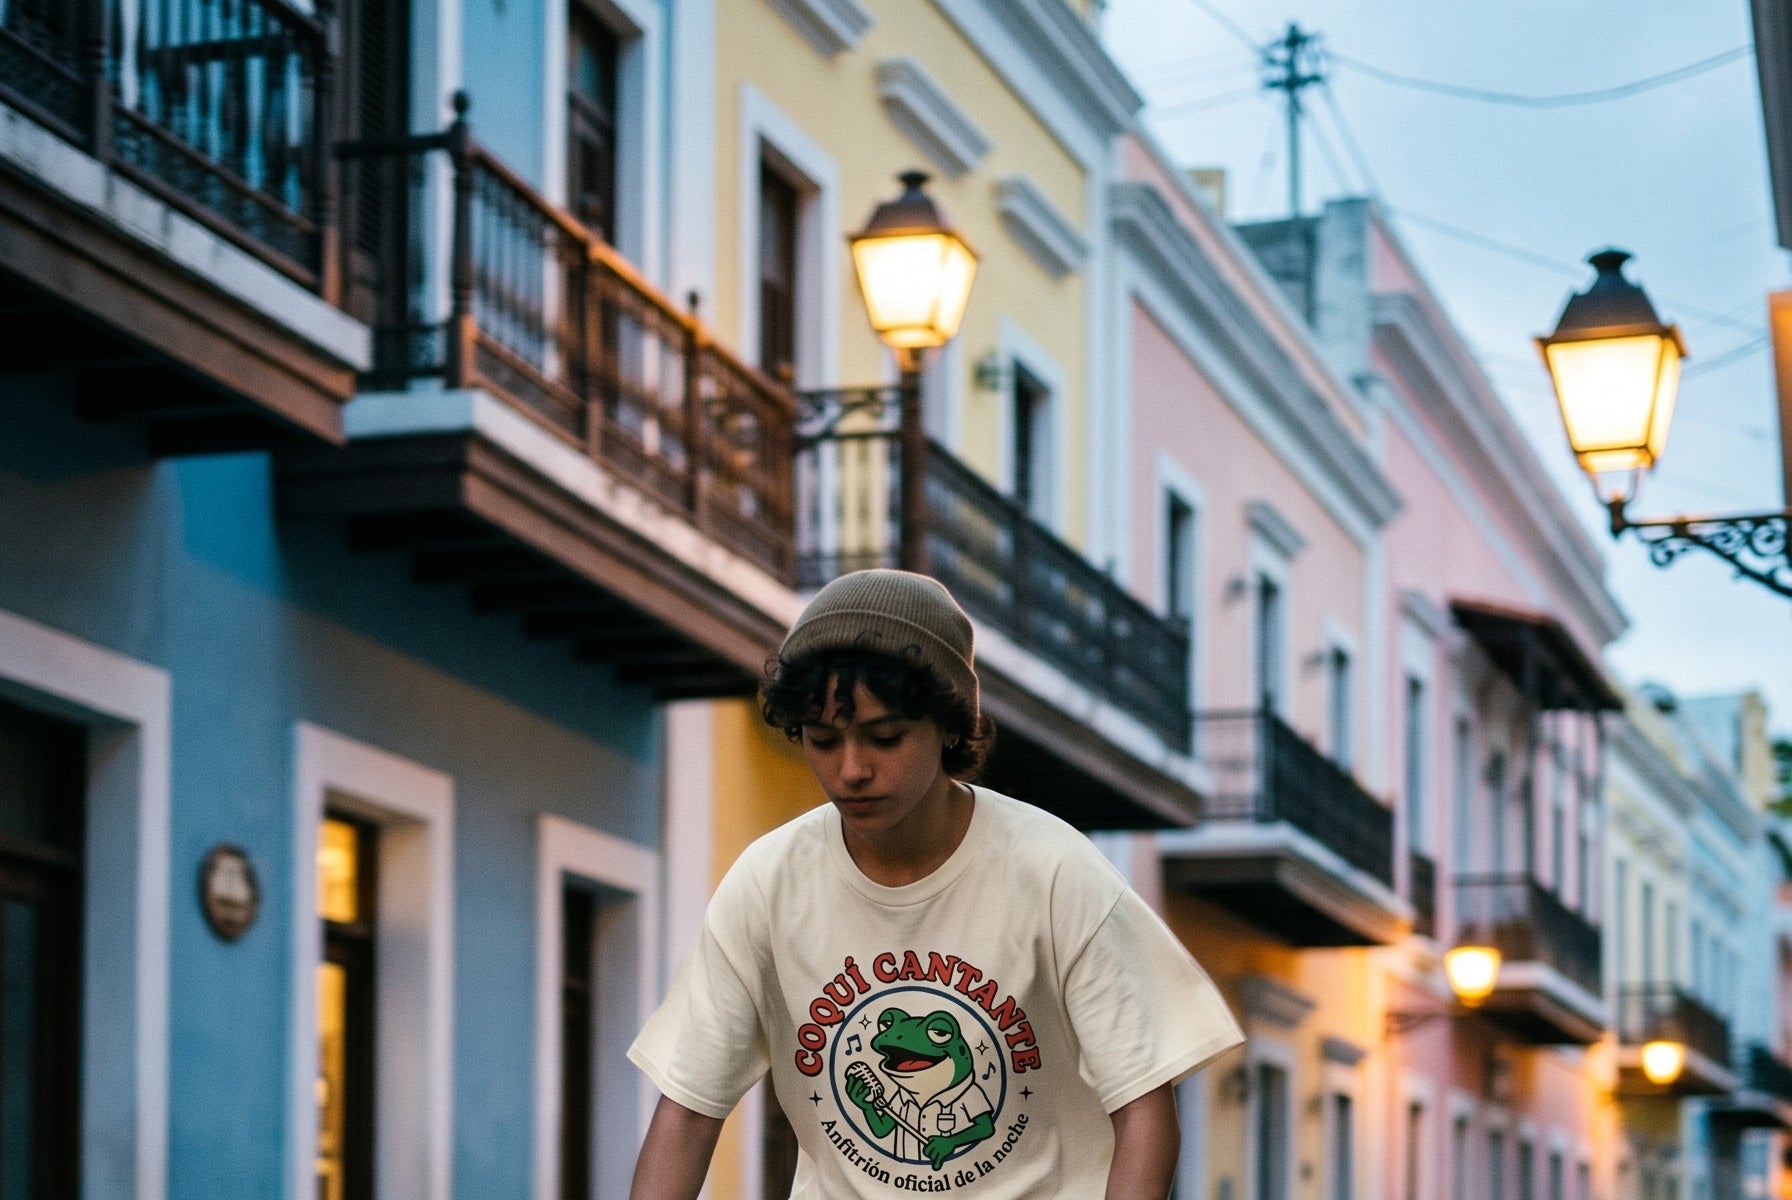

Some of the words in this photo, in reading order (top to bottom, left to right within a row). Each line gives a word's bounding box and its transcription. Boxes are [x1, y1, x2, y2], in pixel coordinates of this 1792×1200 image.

[795, 956, 871, 1077] COQUÍ
[873, 950, 1042, 1074] CANTANTE
[820, 1119, 891, 1184] Anfitrión
[894, 1174, 952, 1193] oficial
[954, 1170, 976, 1189] de
[973, 1160, 995, 1178] la
[993, 1113, 1029, 1163] noche
